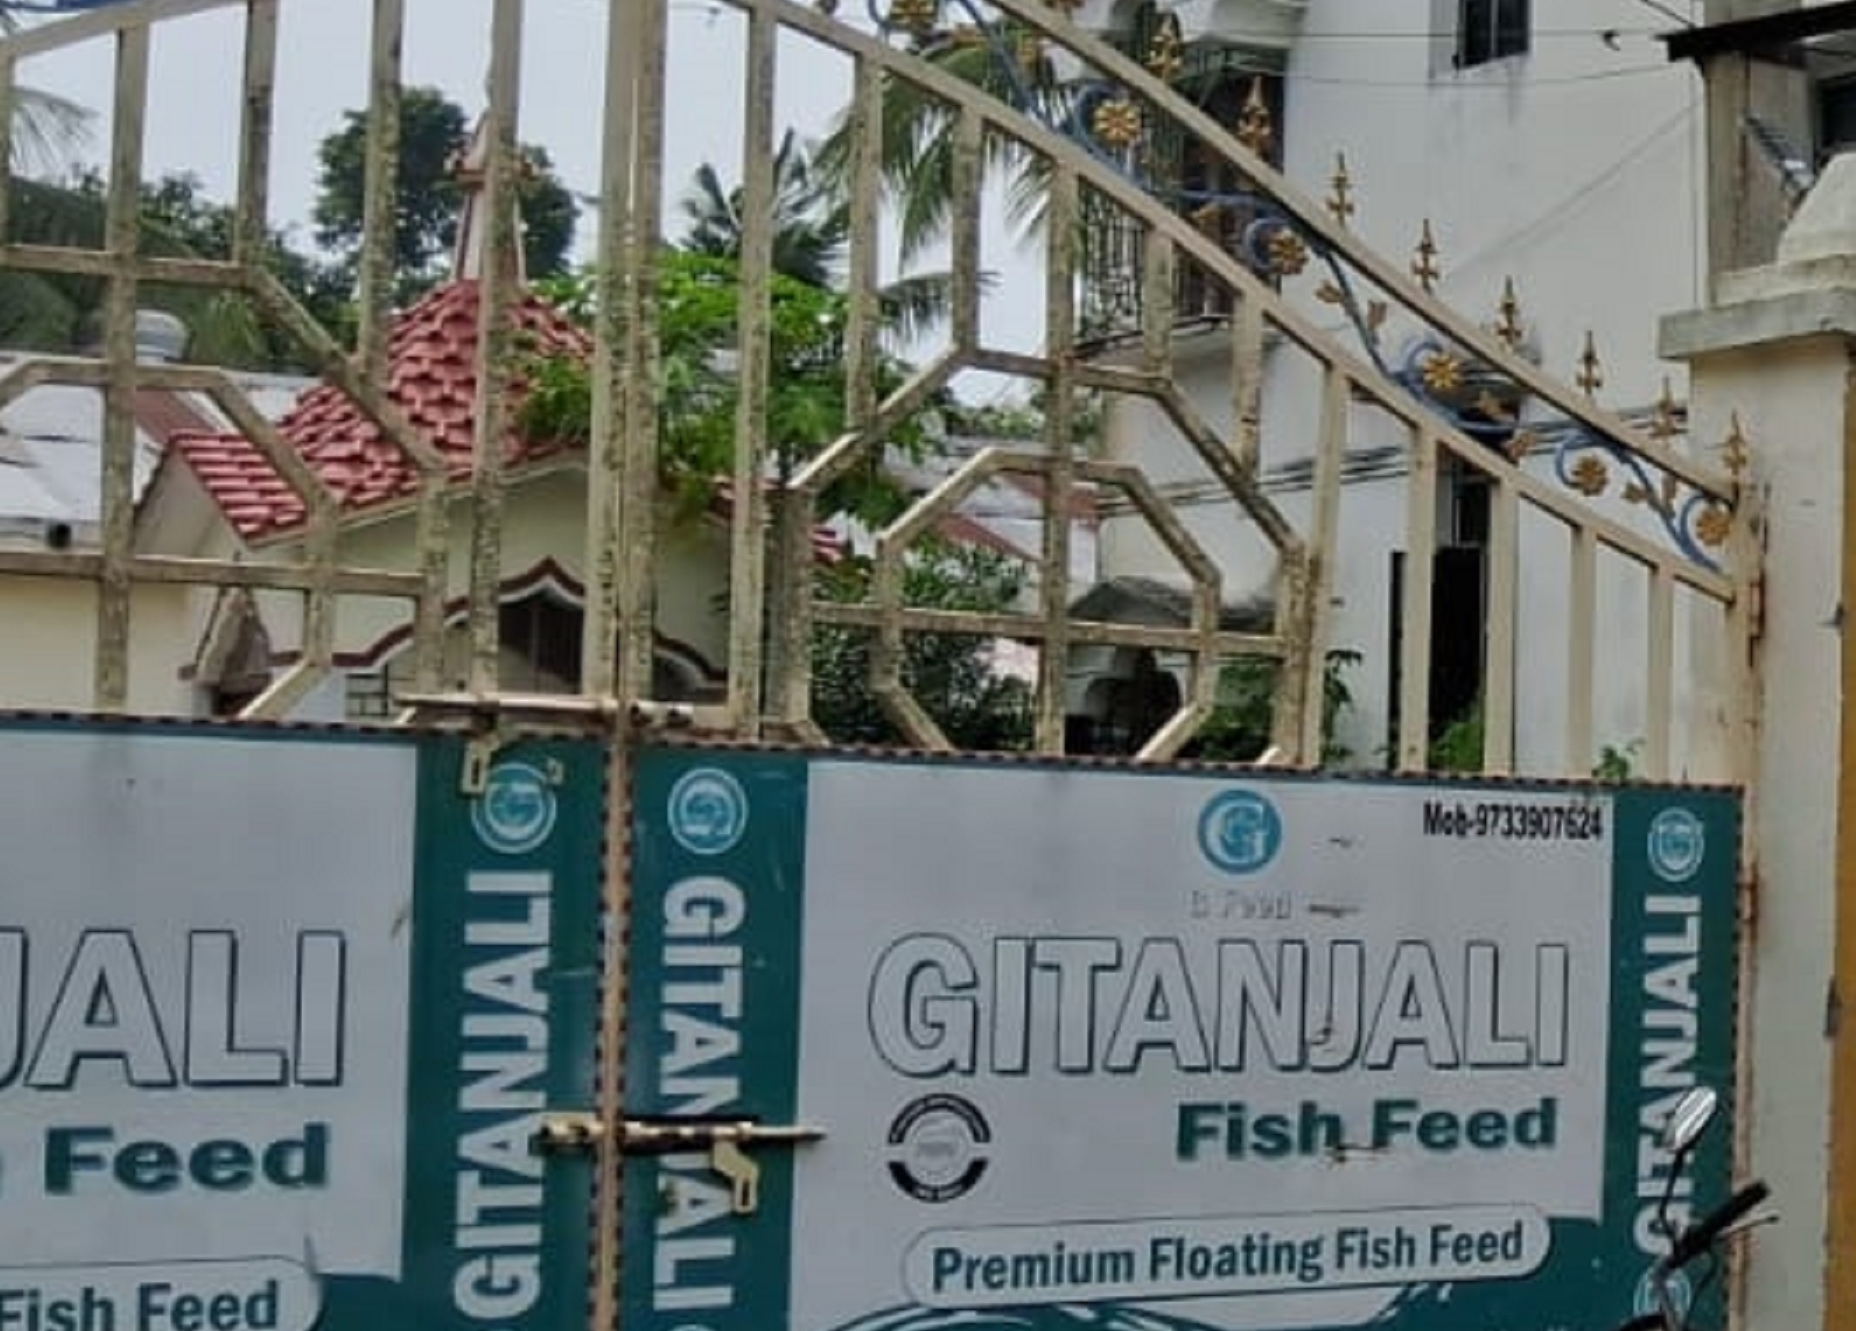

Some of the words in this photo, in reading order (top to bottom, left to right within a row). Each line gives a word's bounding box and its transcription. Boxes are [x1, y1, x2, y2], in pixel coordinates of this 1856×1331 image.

[867, 932, 1569, 1078] GITANJALI
[453, 871, 554, 1320] GITANJALI
[1175, 1100, 1344, 1163] Fish
[1372, 1096, 1556, 1153] Feed
[44, 1122, 330, 1195] Feed
[932, 1242, 1134, 1292] Premium
[1149, 1234, 1324, 1282] Floating
[1335, 1225, 1416, 1271] Fish
[1429, 1219, 1524, 1265] Feed
